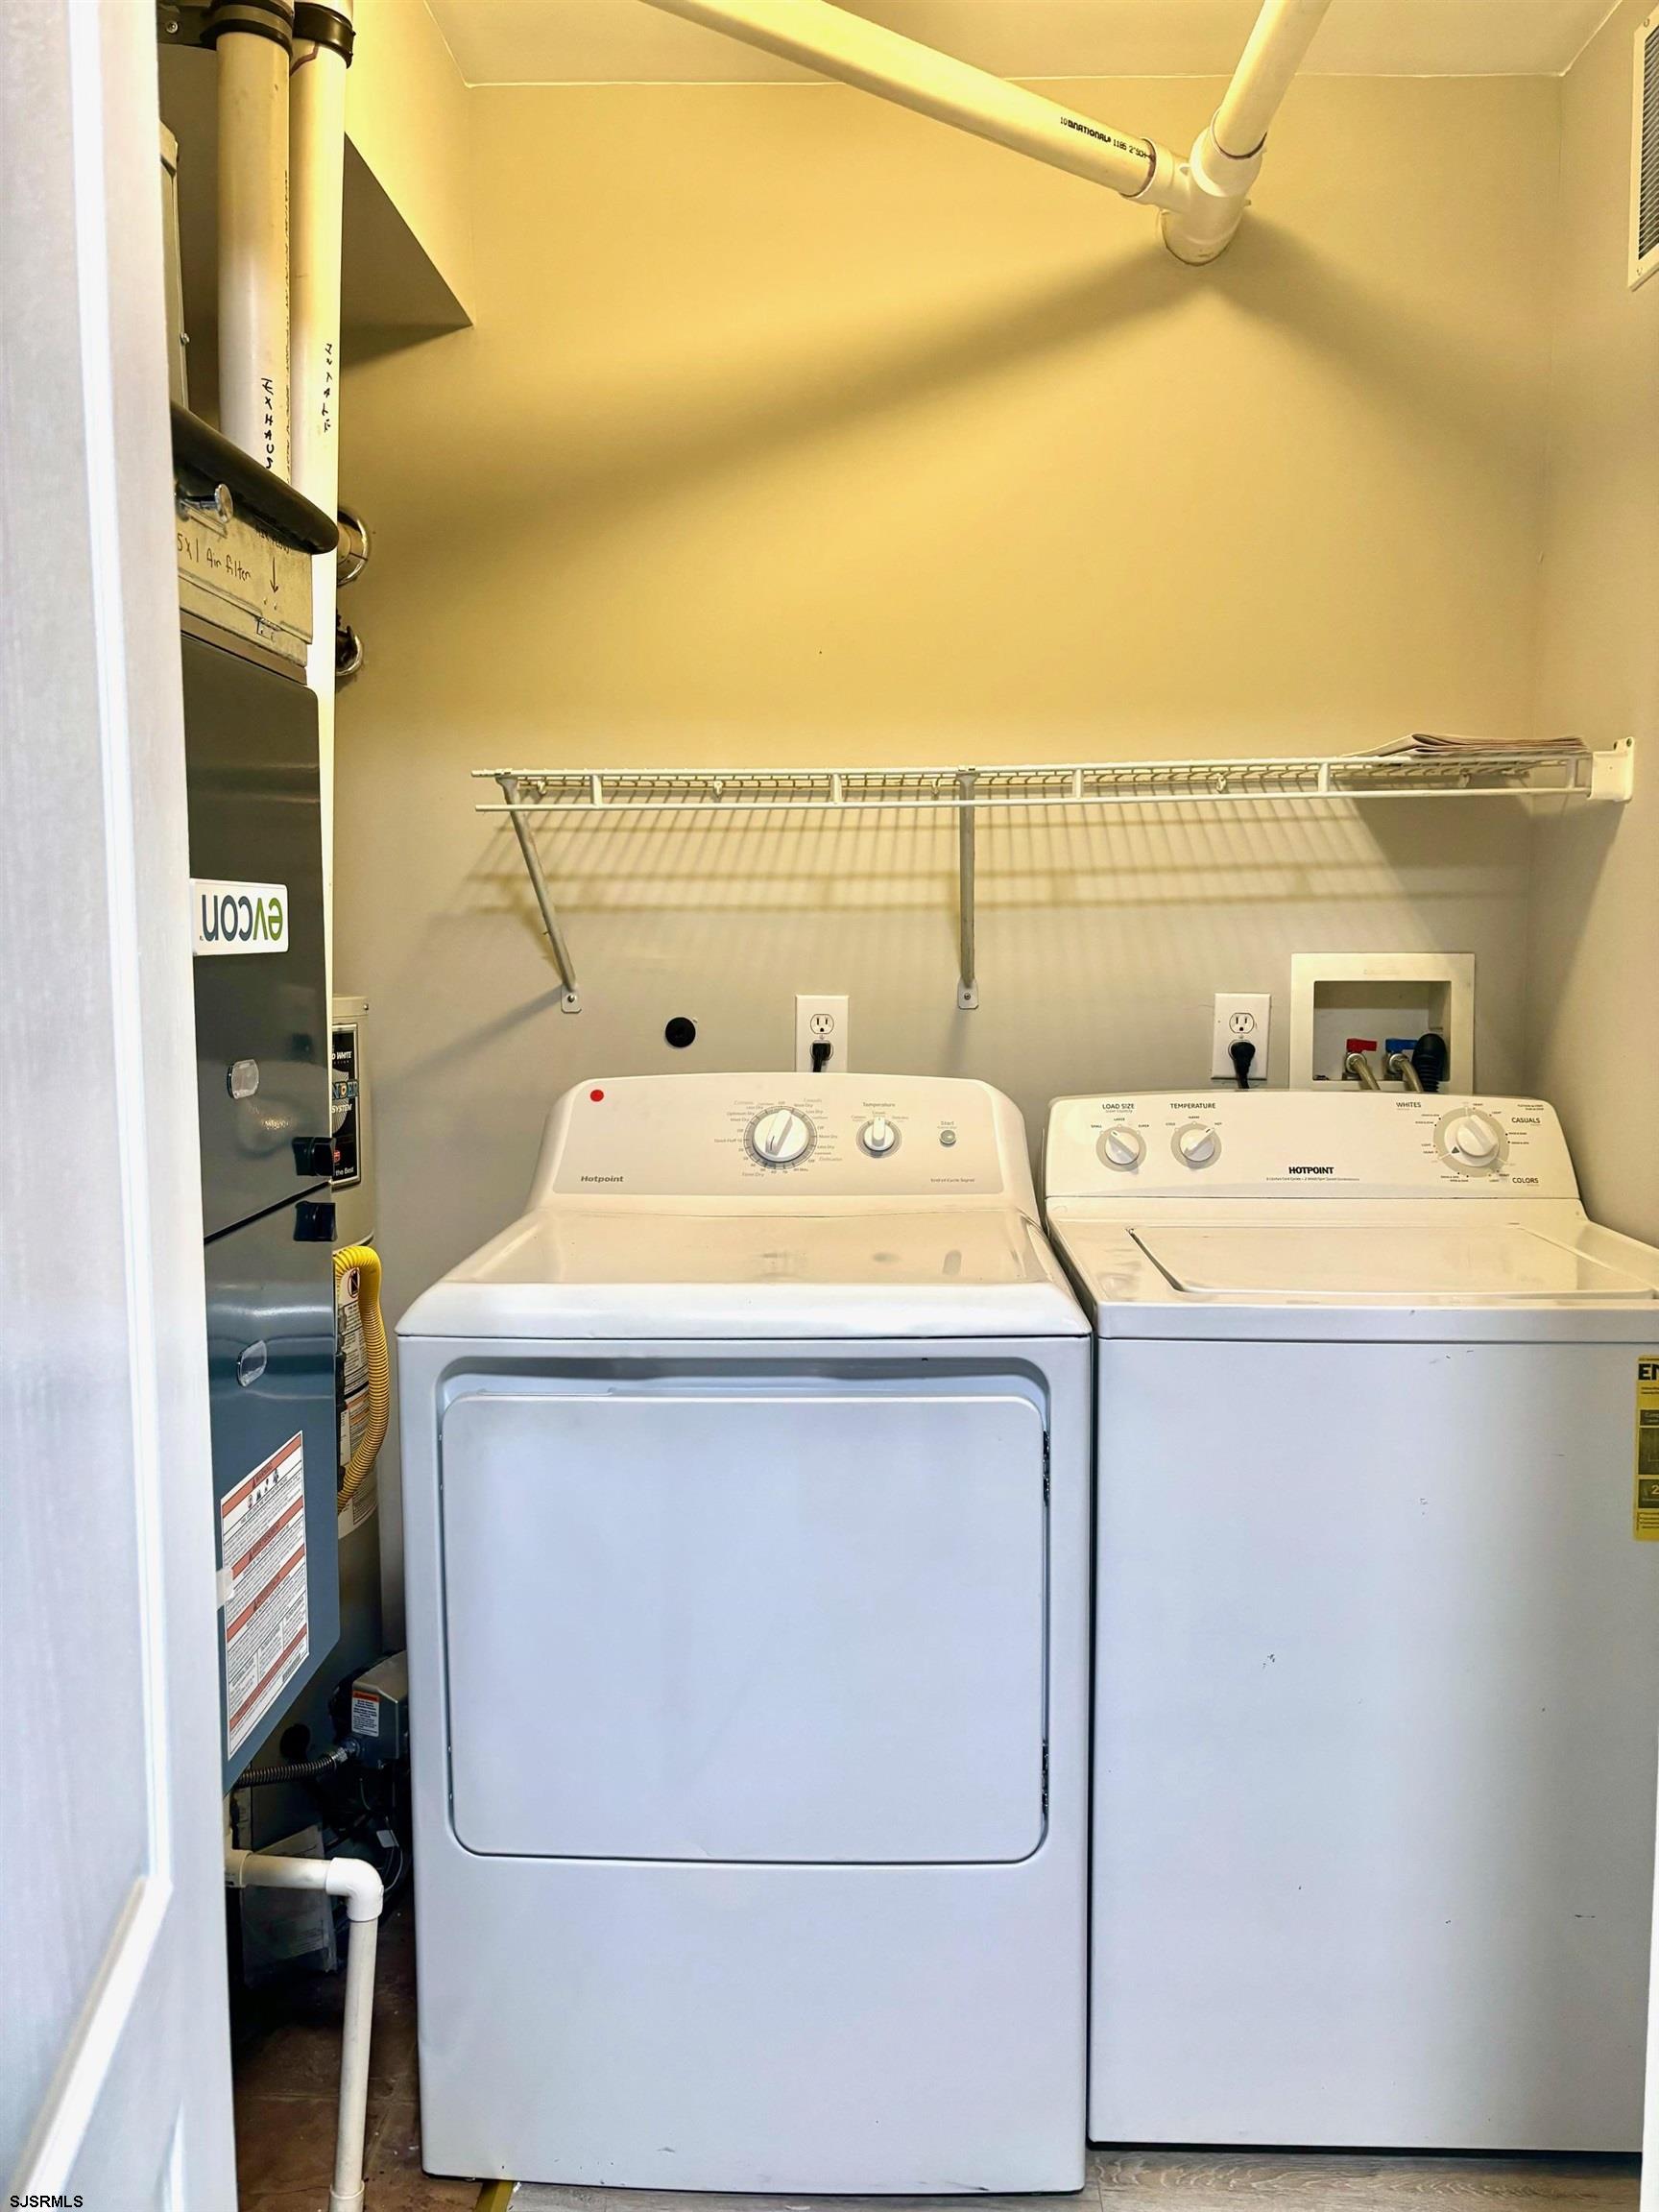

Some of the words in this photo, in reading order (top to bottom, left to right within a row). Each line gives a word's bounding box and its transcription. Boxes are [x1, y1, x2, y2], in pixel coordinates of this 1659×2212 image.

[261, 377, 275, 469] EXHAUS
[202, 894, 283, 942] evcon
[336, 1050, 352, 1060] WHITE
[580, 1175, 625, 1184] Hotpoint
